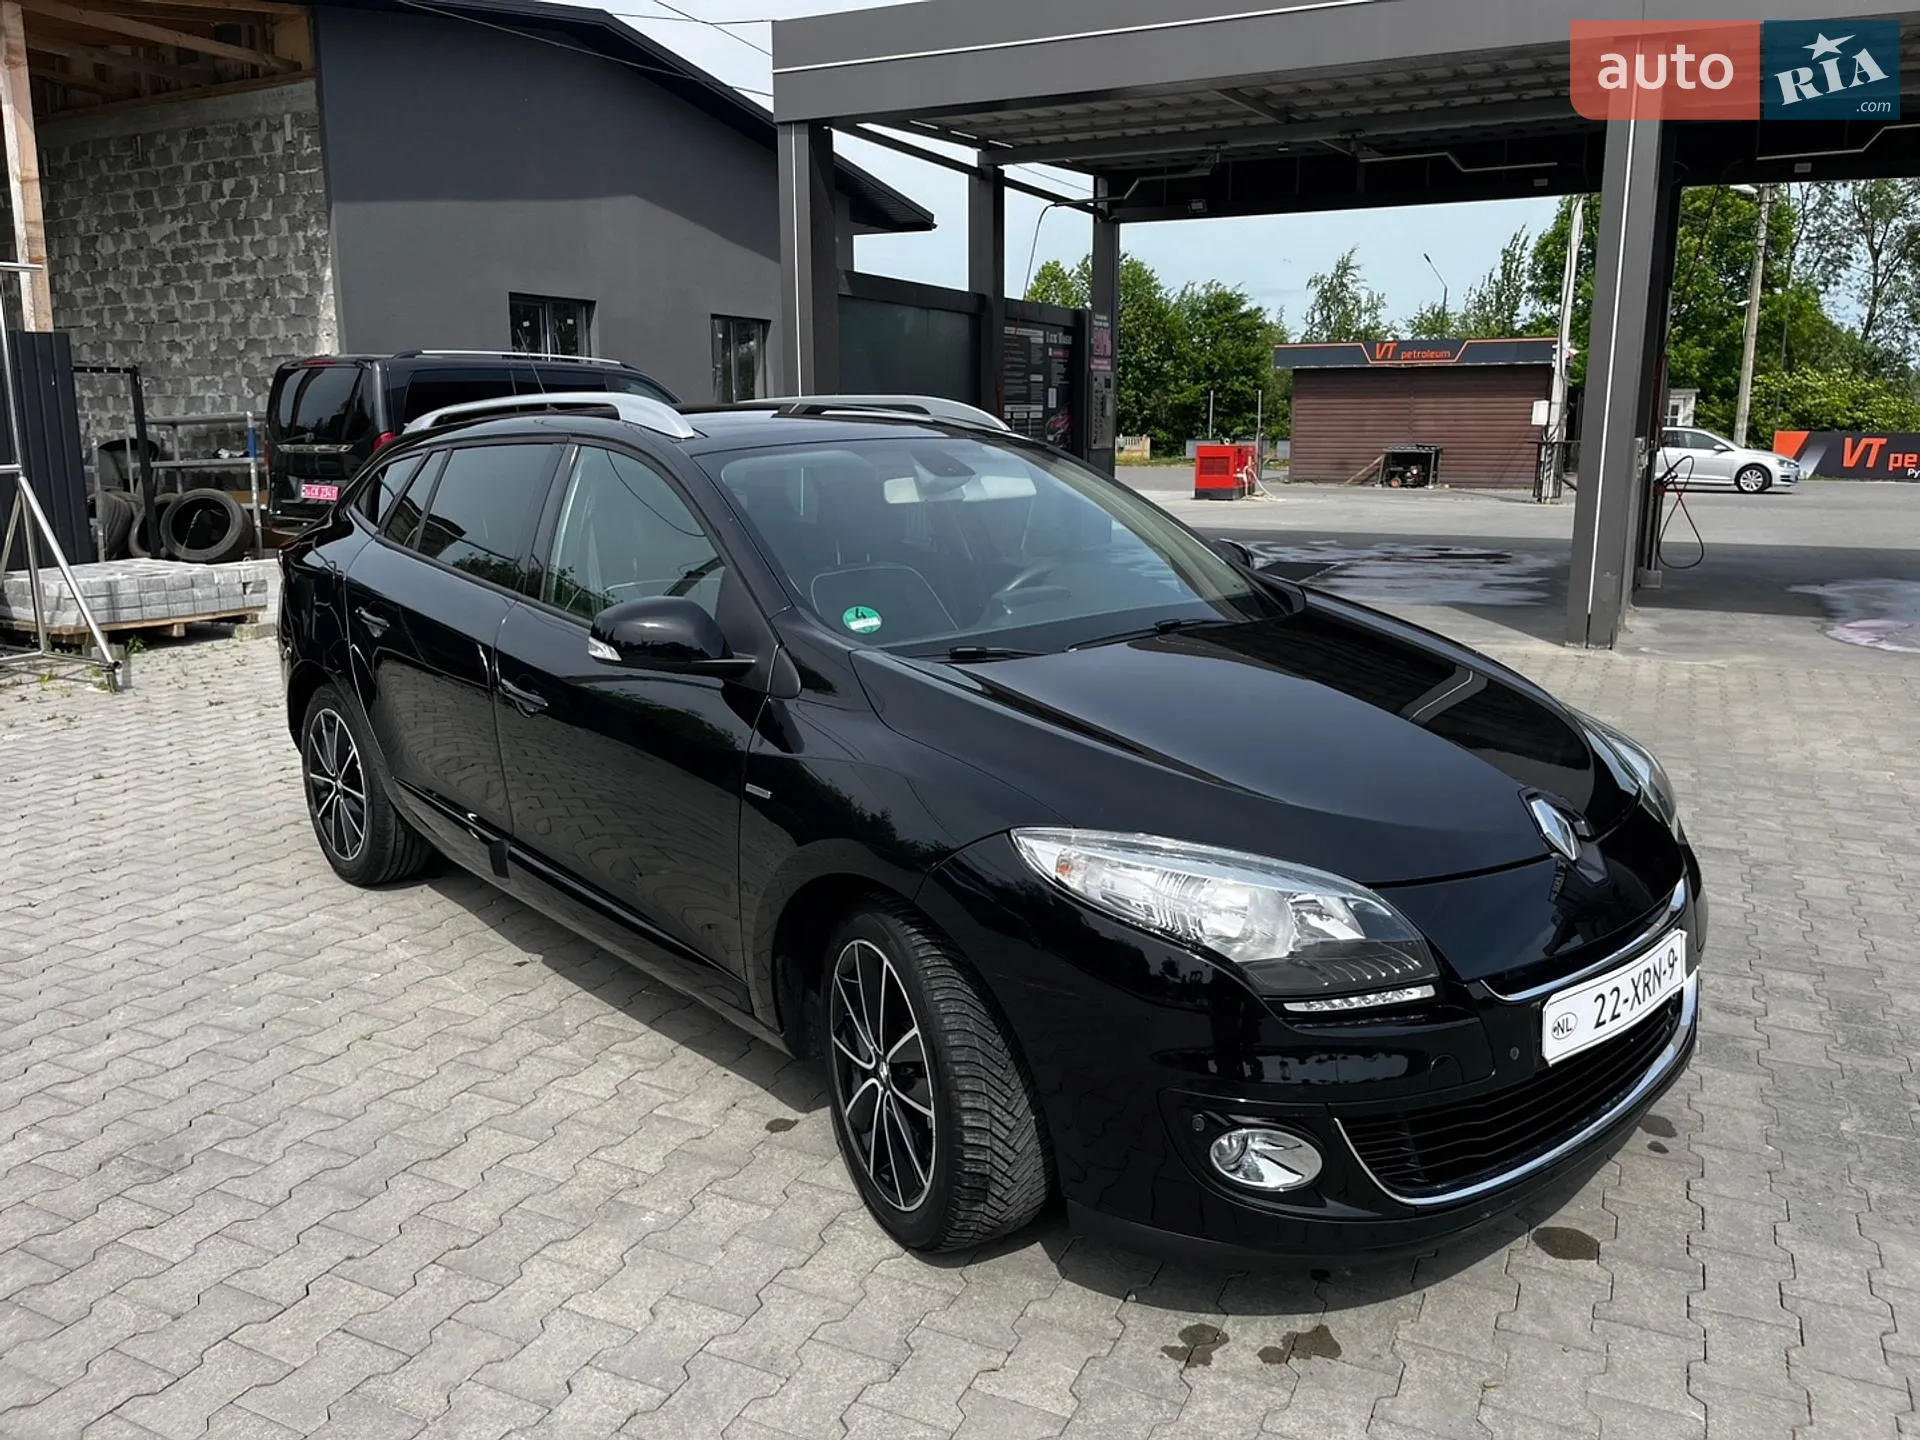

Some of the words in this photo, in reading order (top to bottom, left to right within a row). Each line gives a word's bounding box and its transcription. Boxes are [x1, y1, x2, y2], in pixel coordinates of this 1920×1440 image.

[1376, 343, 1397, 359] VT
[1401, 350, 1451, 360] petroleum
[1843, 437, 1888, 468] VT
[1593, 948, 1675, 1030] 22-XRN-9
[1556, 1016, 1573, 1036] NL
